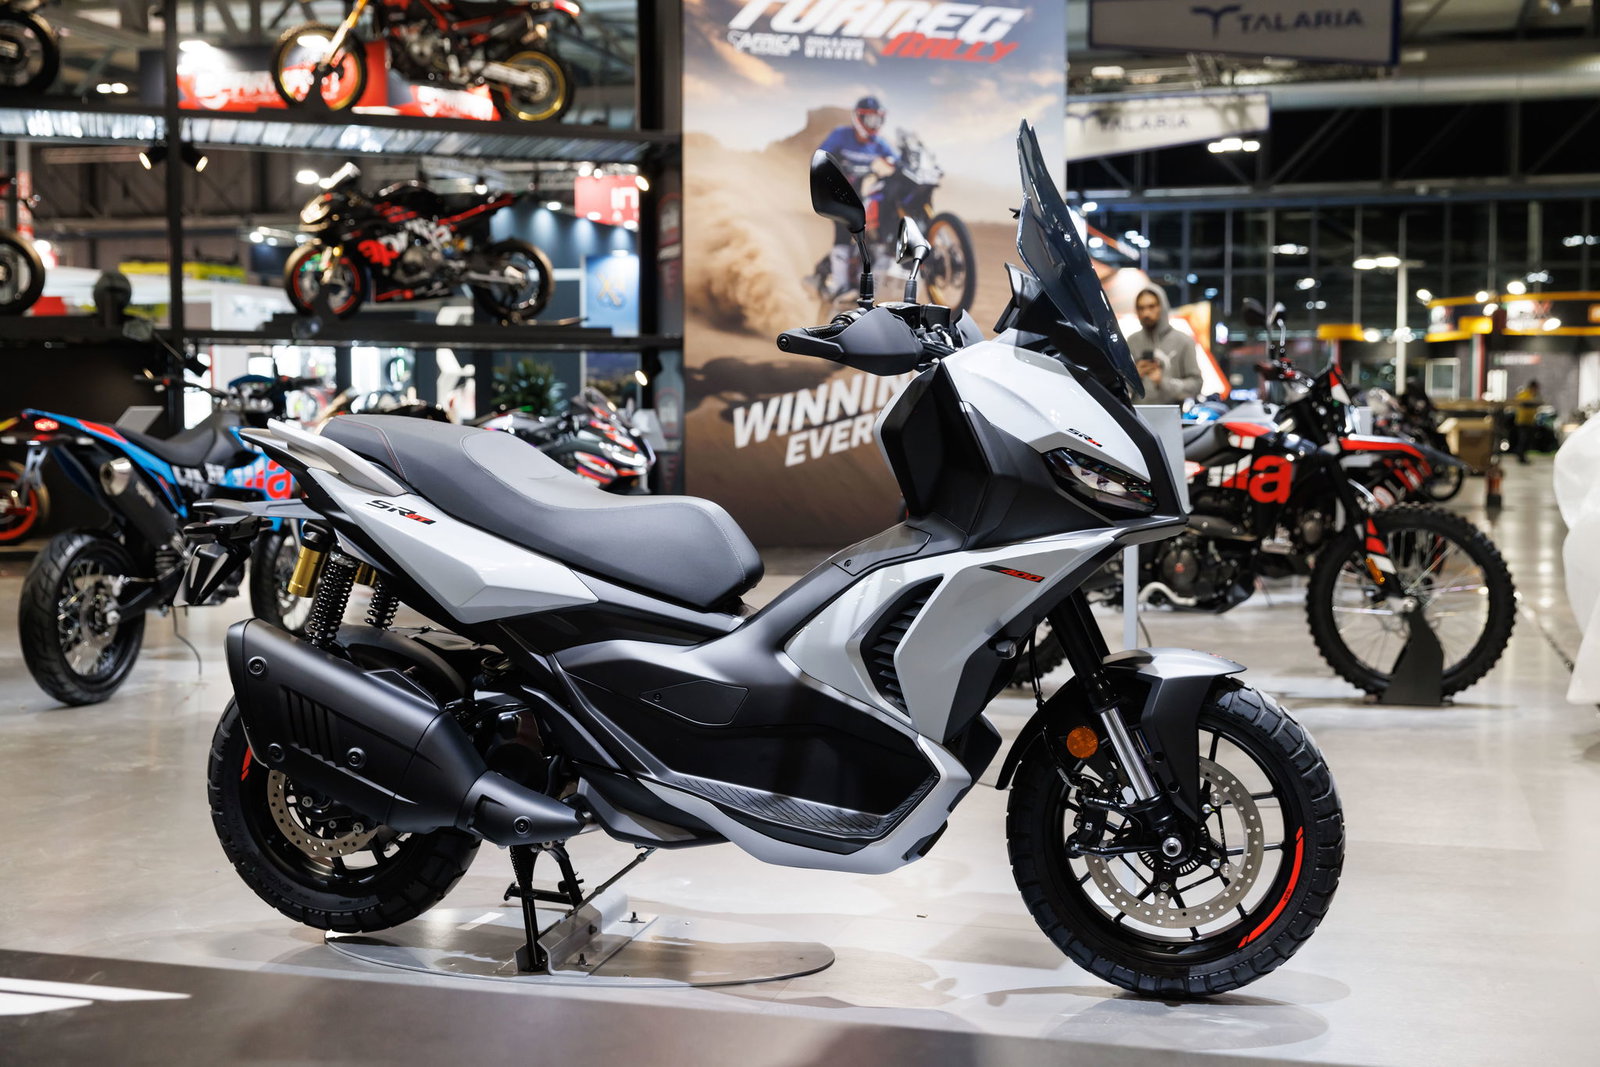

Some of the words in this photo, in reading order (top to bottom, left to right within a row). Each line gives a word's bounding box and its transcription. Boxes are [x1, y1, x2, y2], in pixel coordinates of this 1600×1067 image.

[1238, 8, 1364, 34] TALARIA
[880, 32, 1020, 64] RALLY
[733, 370, 919, 448] WINNIN
[785, 411, 878, 467] EVER
[365, 500, 417, 516] SR
[1000, 569, 1044, 582] 400
